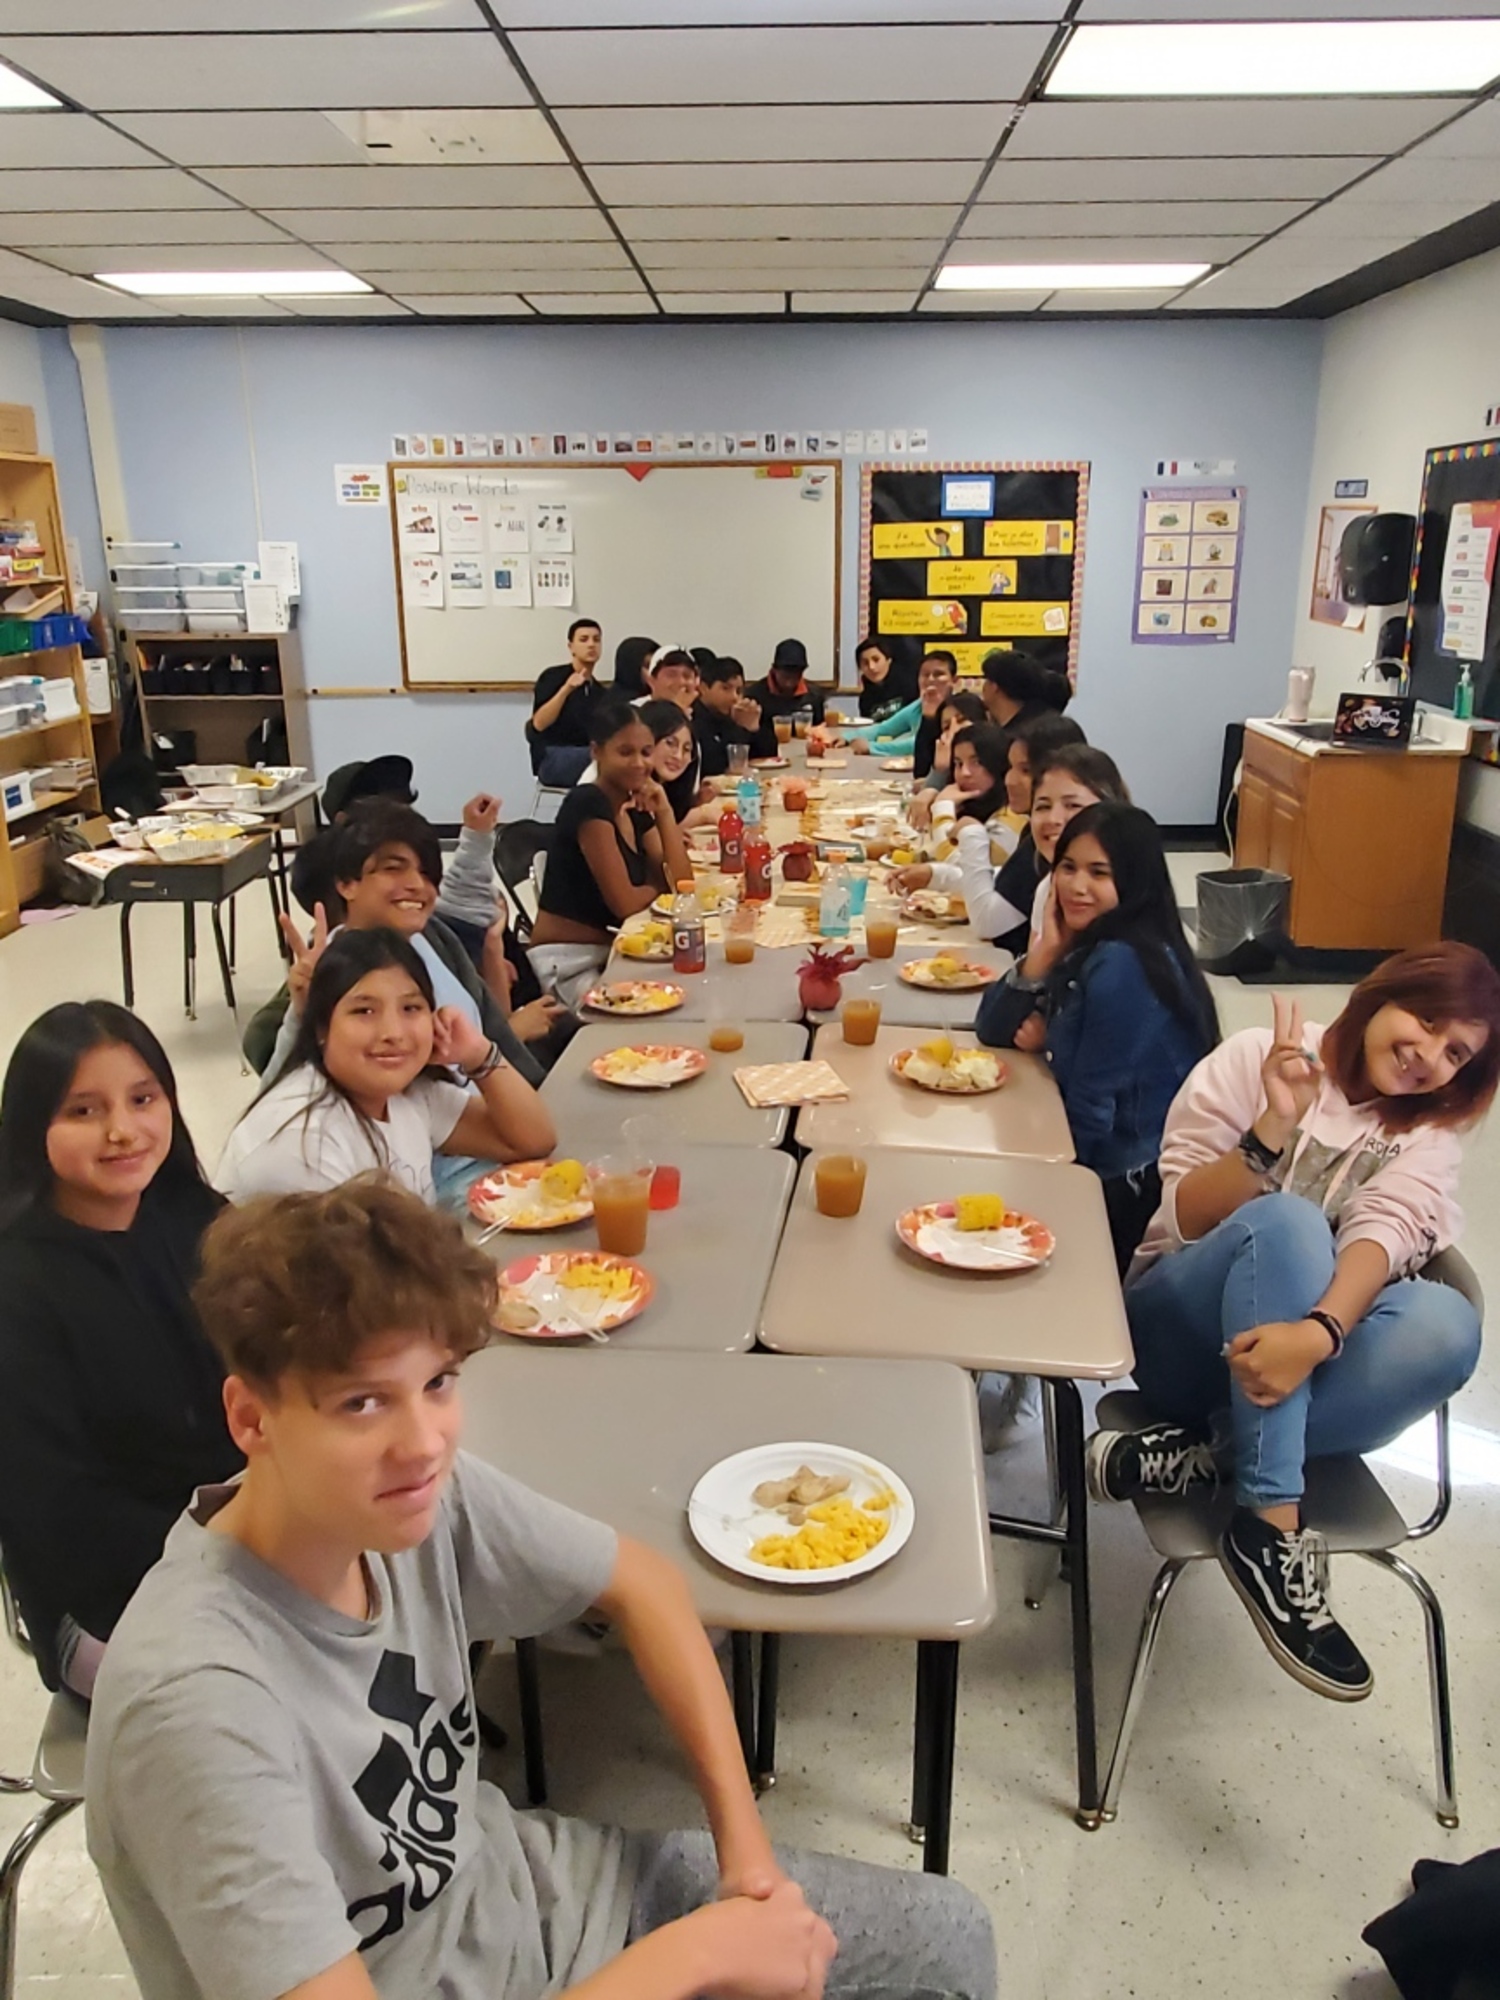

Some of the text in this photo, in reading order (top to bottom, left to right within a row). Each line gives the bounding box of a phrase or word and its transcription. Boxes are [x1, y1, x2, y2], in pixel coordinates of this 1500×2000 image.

[406, 474, 520, 496] Power Words
[725, 841, 738, 855] G
[675, 931, 690, 950] G
